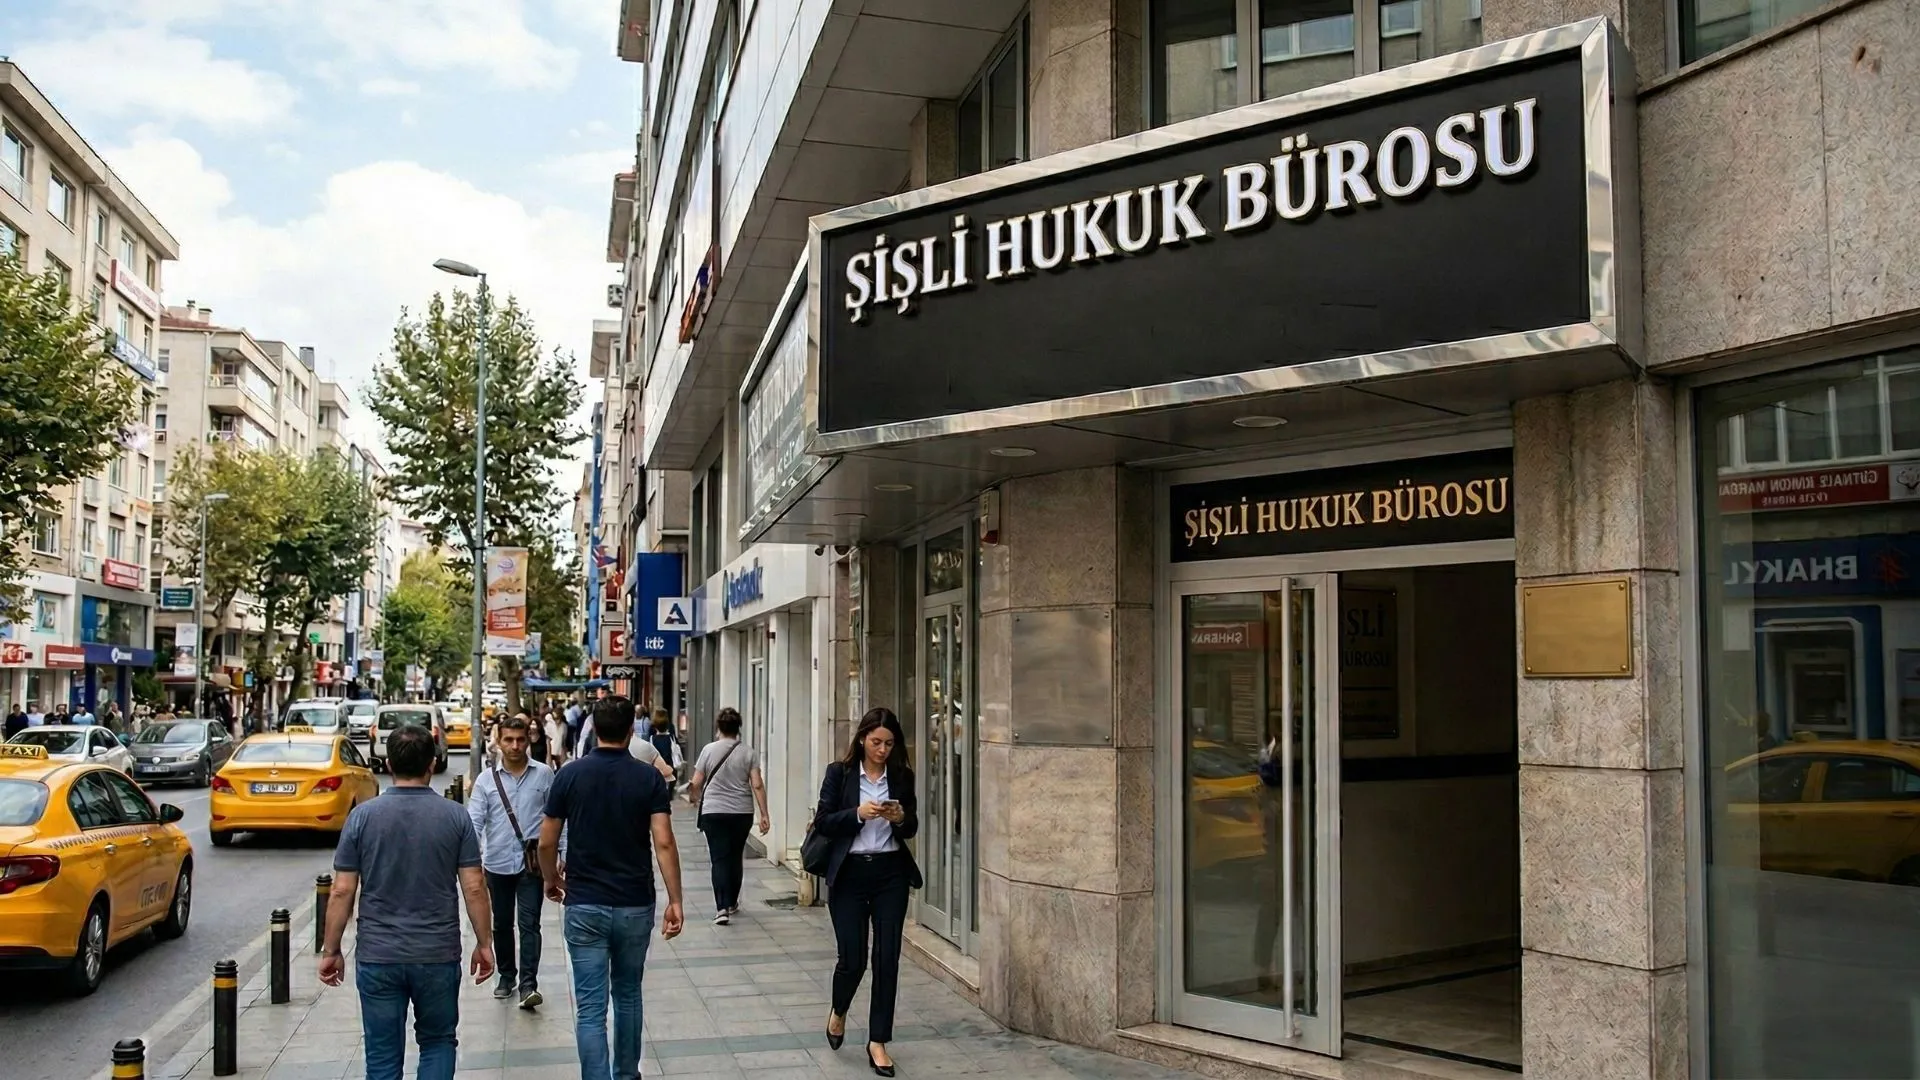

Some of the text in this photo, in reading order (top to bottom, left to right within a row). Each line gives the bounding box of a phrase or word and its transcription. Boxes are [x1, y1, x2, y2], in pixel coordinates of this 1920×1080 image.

[844, 97, 1538, 324] ŞİŞLİ HUKUK BÜROSU
[1184, 477, 1508, 546] ŞİŞLİ HUKUK BÜROSU
[1346, 604, 1386, 644] ŞLİ
